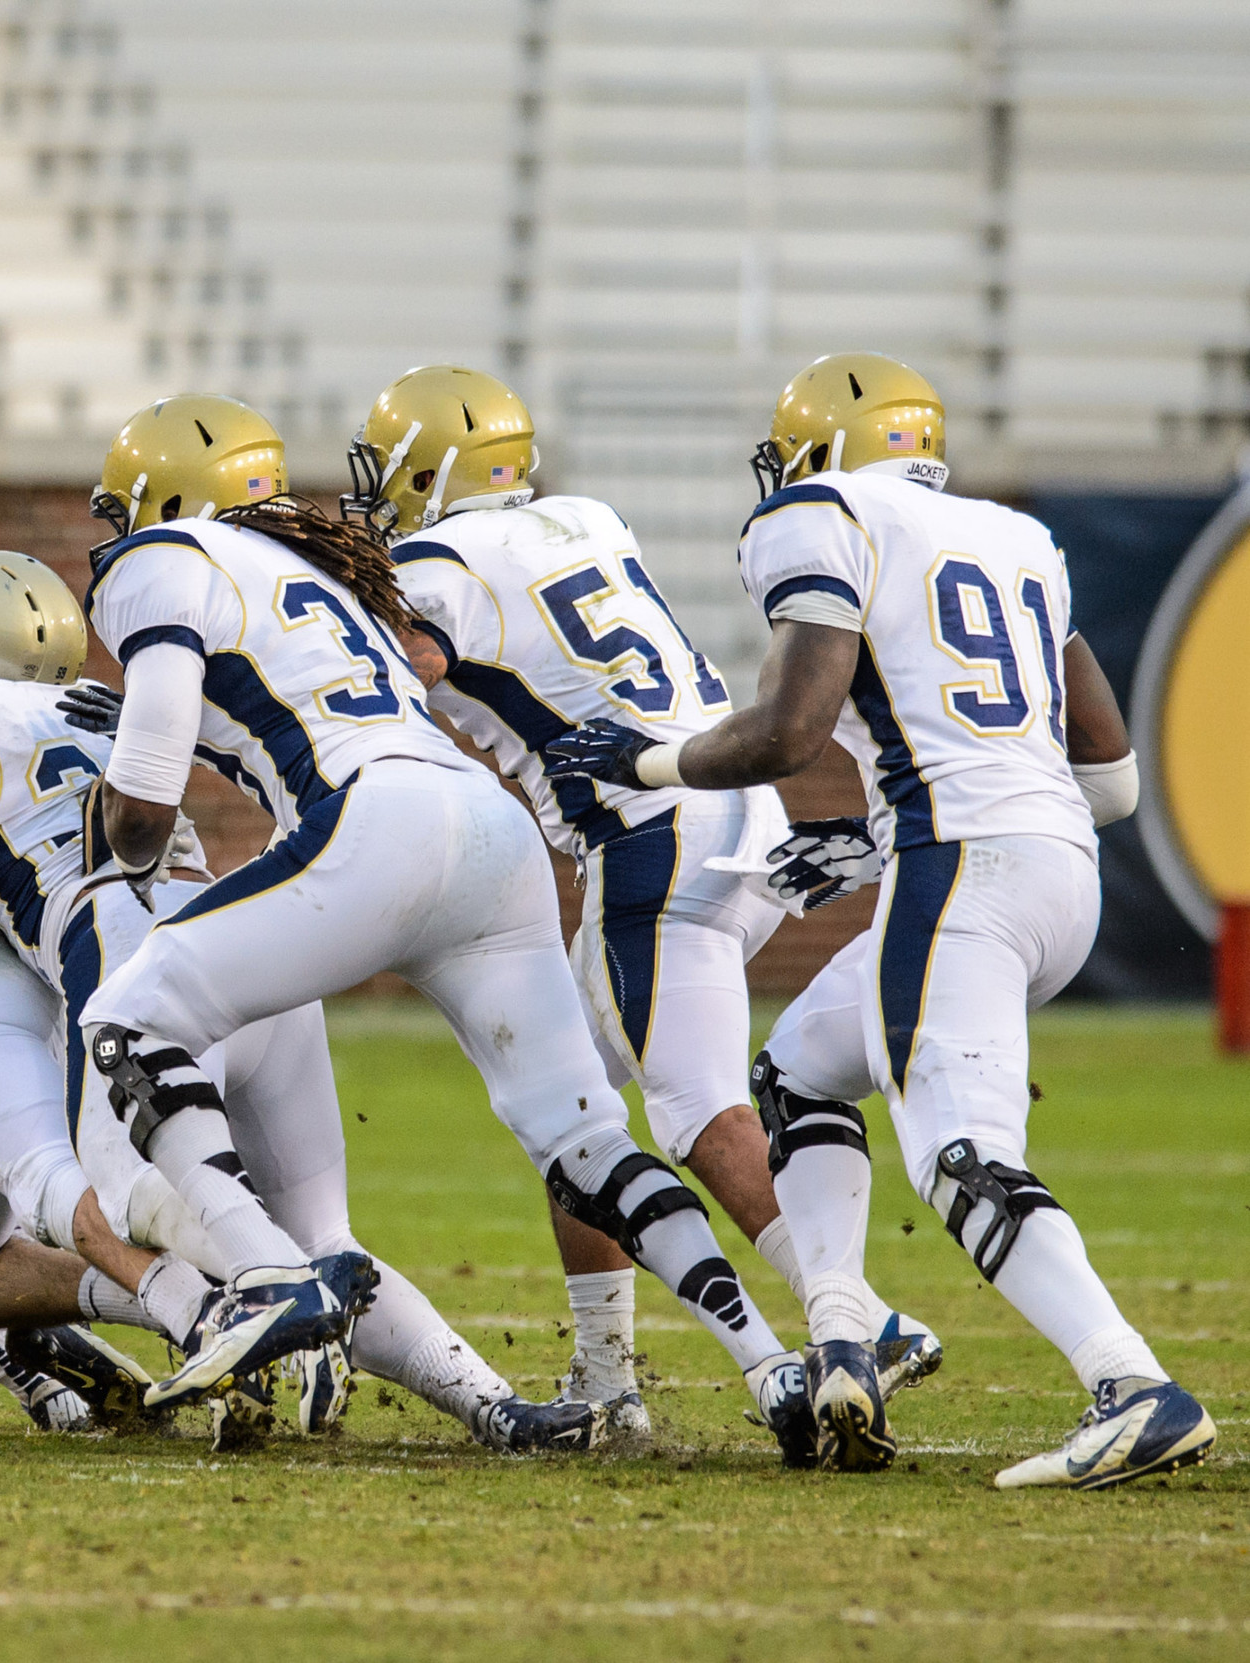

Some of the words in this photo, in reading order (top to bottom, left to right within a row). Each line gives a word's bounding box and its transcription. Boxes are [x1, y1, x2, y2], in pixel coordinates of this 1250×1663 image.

[907, 462, 947, 481] JACKETS
[922, 436, 931, 451] 91
[526, 549, 733, 722] 51
[925, 549, 1068, 757] 91
